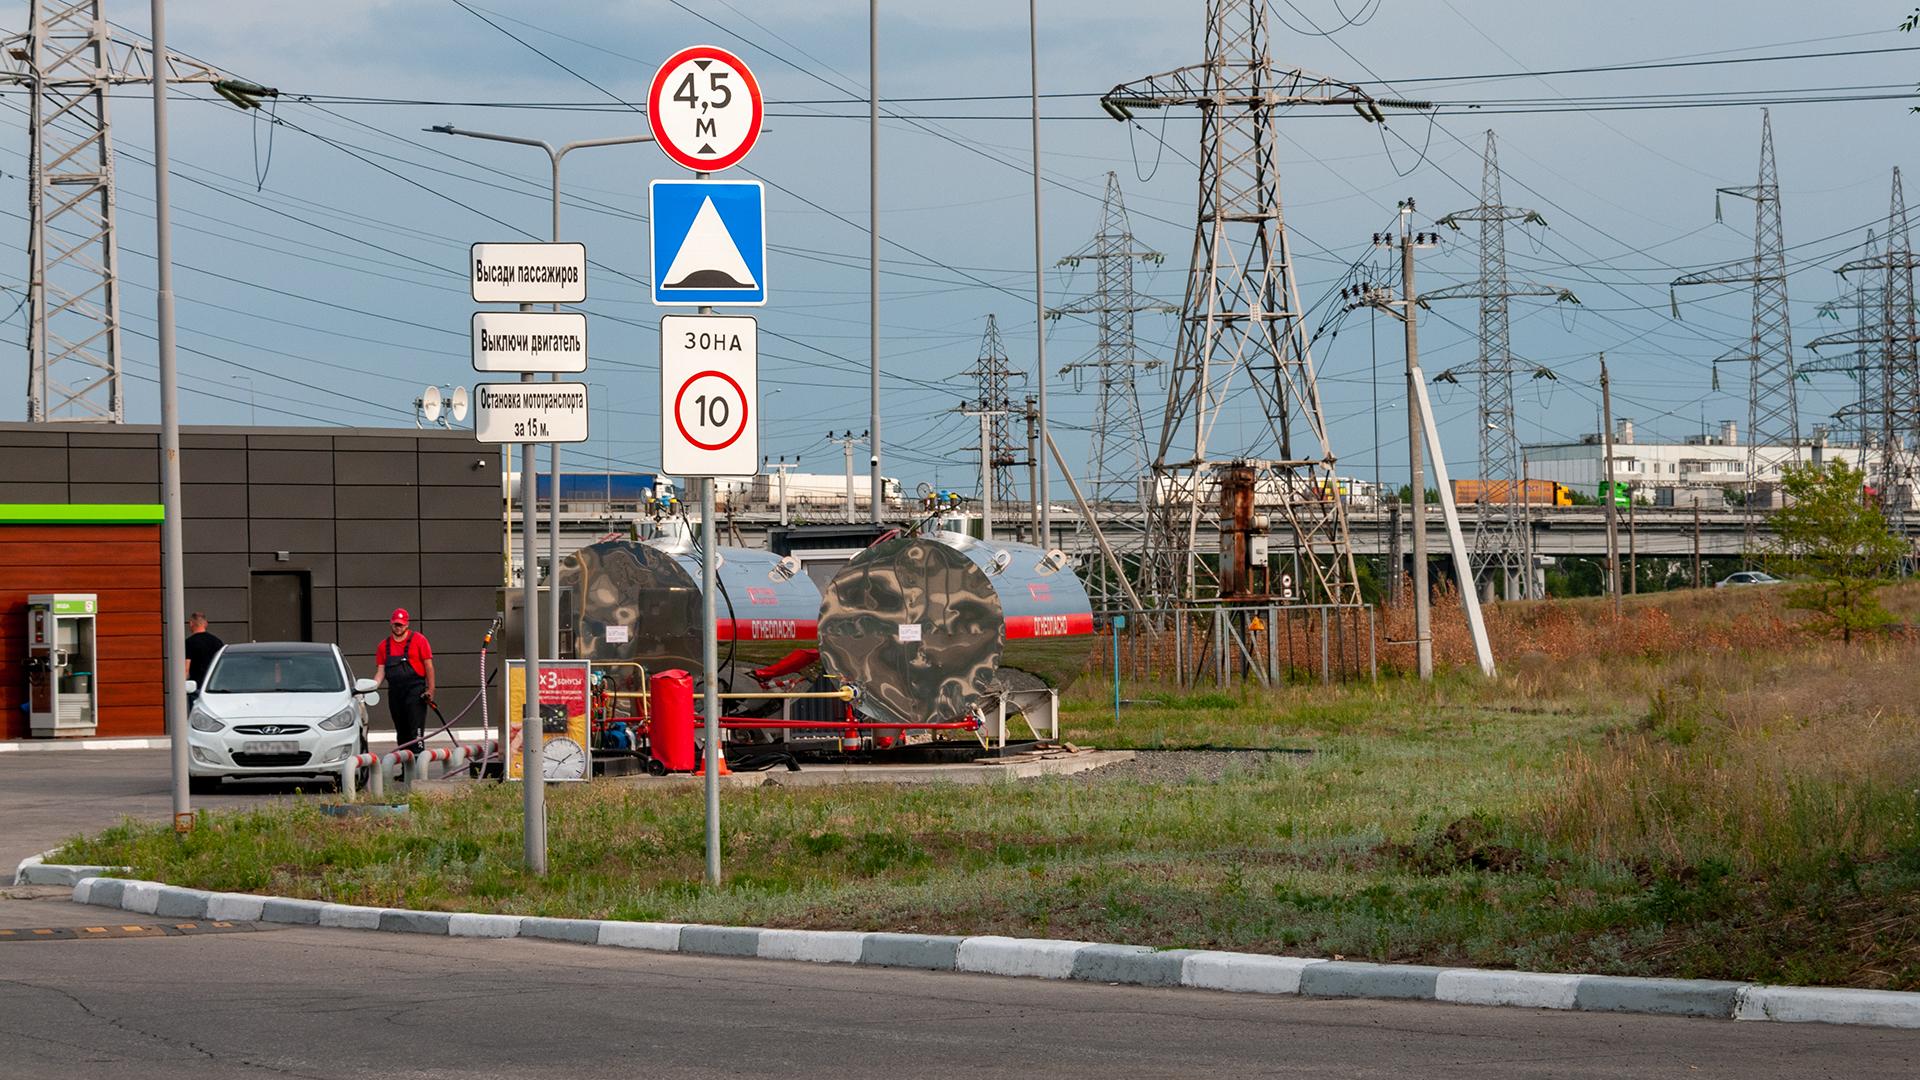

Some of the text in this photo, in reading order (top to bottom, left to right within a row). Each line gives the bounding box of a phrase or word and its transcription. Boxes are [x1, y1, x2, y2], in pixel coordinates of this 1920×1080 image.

[673, 72, 732, 115] 4,5
[476, 259, 579, 289] Высади пассажиров
[481, 328, 581, 356] Выключи двигатель
[684, 332, 742, 351] ЗОНА
[481, 387, 584, 414] Остановка мототранспорта
[695, 395, 729, 428] 10
[514, 417, 549, 437] за 15 м.
[751, 619, 796, 639] ОГНЕОПАСНО
[1033, 615, 1068, 636] ОГНЕОПАСНО
